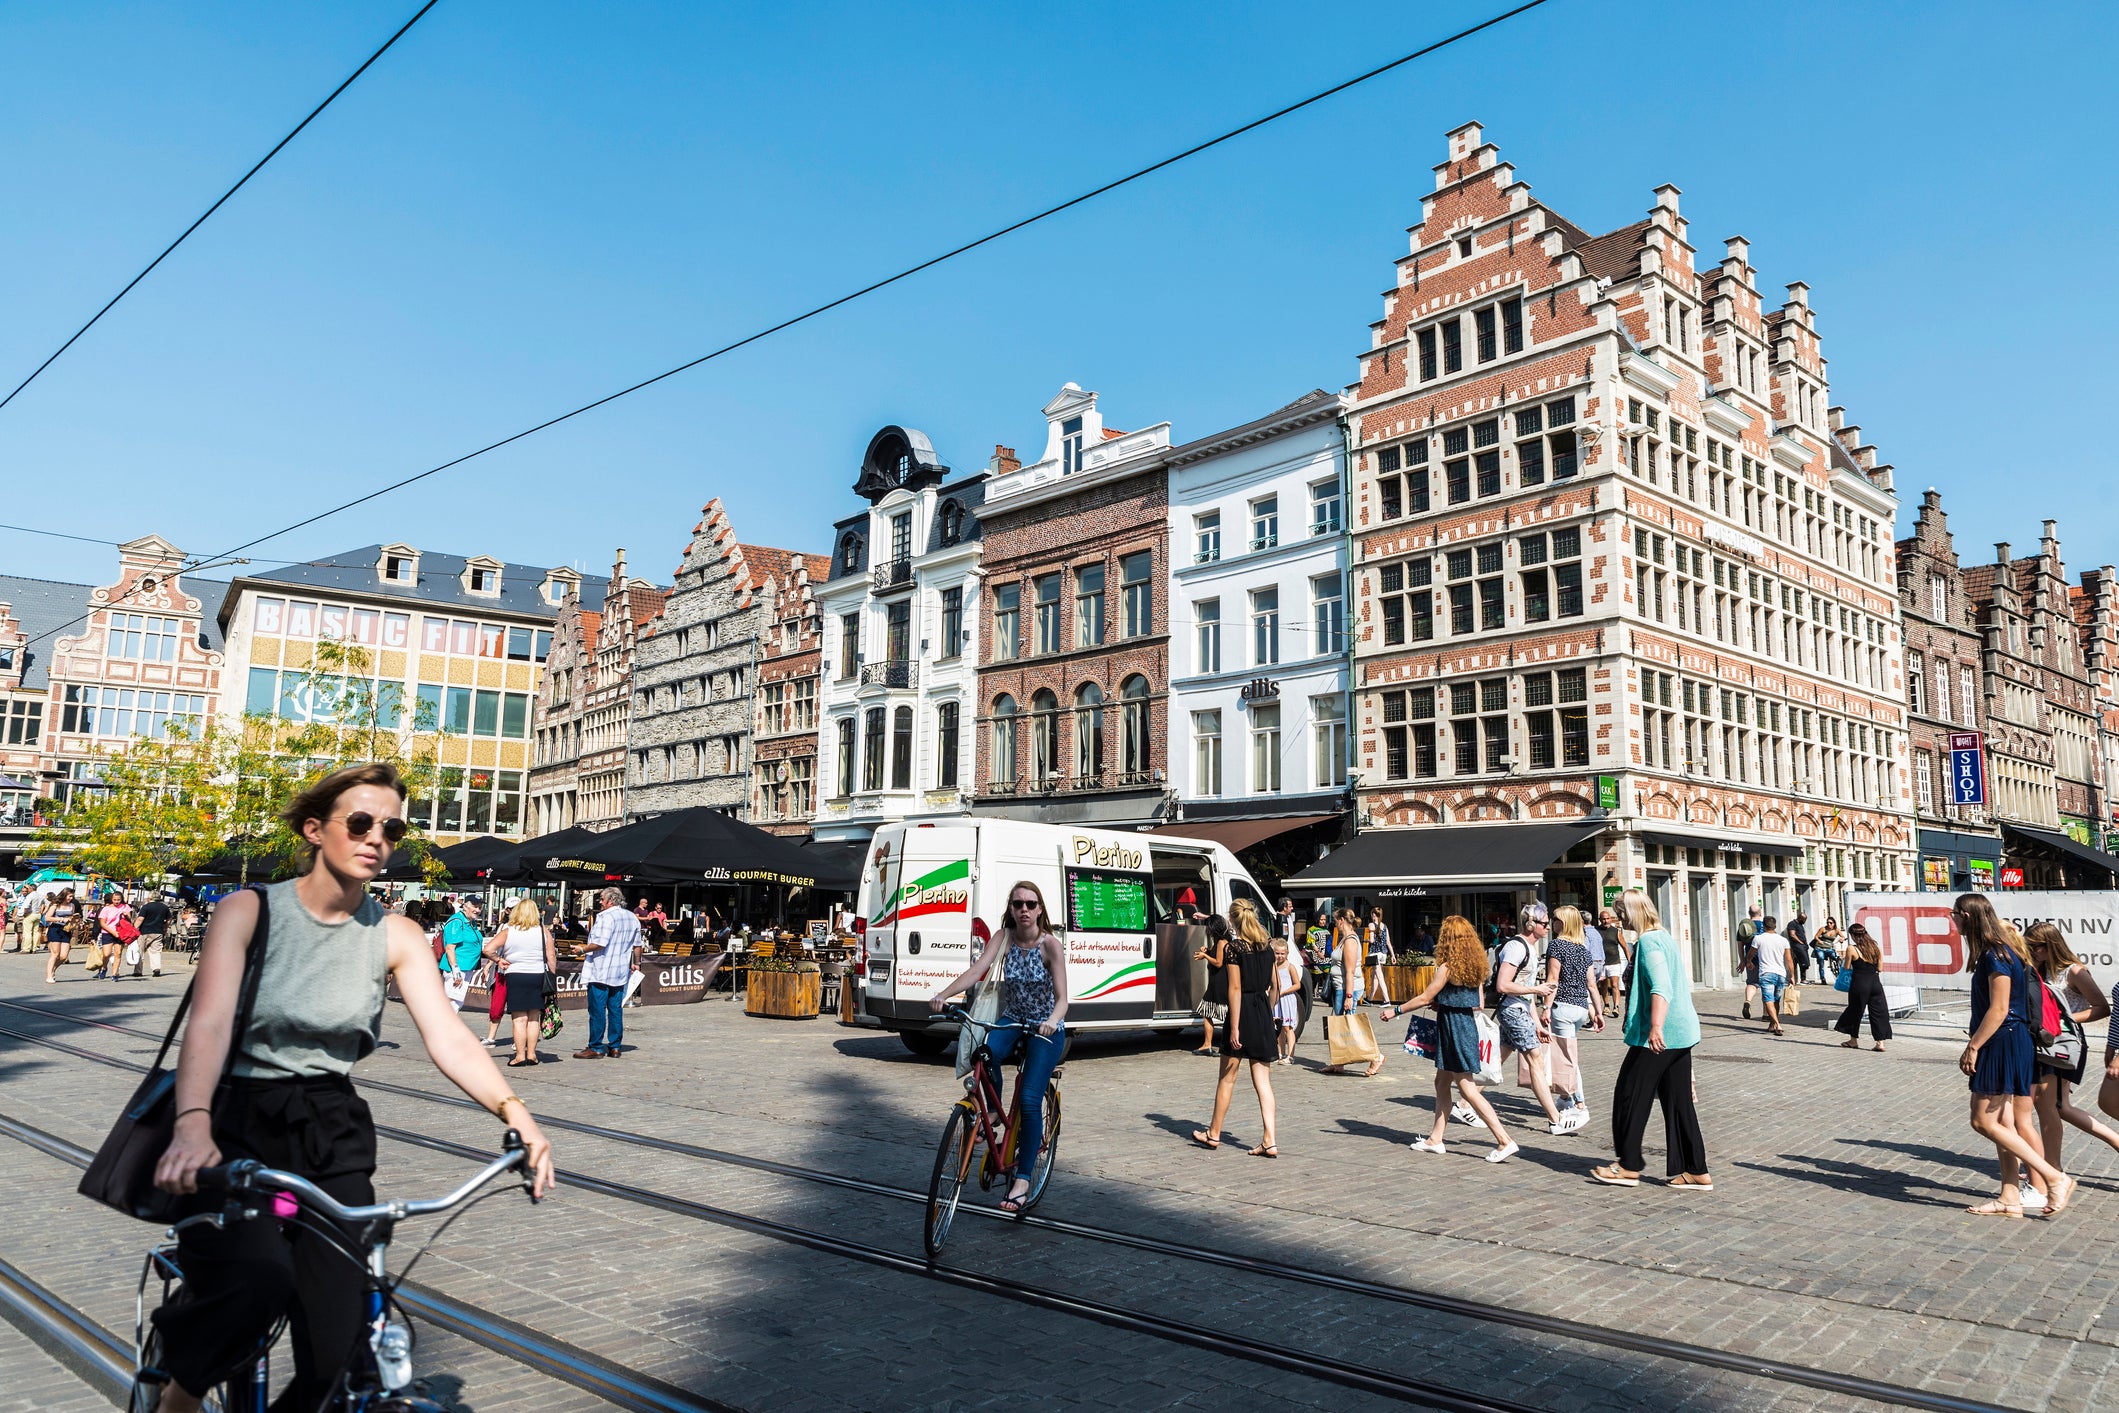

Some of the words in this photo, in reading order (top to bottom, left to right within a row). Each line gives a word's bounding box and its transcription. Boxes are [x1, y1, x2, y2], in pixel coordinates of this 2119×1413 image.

[257, 599, 406, 646] BASIC
[424, 620, 502, 657] FIT
[1241, 677, 1280, 700] ellis
[1959, 751, 1975, 802] SHOP
[1072, 835, 1142, 870] Pierino
[546, 857, 560, 869] ellis
[583, 861, 606, 872] BURGER
[704, 867, 731, 880] ellis
[733, 871, 779, 882] GOURMET
[780, 874, 815, 887] BURGER
[2002, 871, 2022, 885] illy
[902, 883, 969, 906] Pierino
[1378, 888, 1402, 897] nature's
[1403, 886, 1427, 896] kitchen
[2081, 918, 2113, 934] NV
[930, 942, 967, 950] DUCATO
[1070, 940, 1087, 951] Echt
[1088, 940, 1121, 952] artisanaal
[1121, 940, 1141, 952] bereid
[1069, 956, 1096, 965] Italiaans
[1096, 957, 1105, 968] ijs
[659, 965, 704, 987] ellis
[898, 968, 913, 976] Echt
[914, 969, 945, 978] artisanaal
[945, 969, 963, 978] bere
[897, 978, 922, 987] Italiaans
[923, 980, 931, 989] ijs
